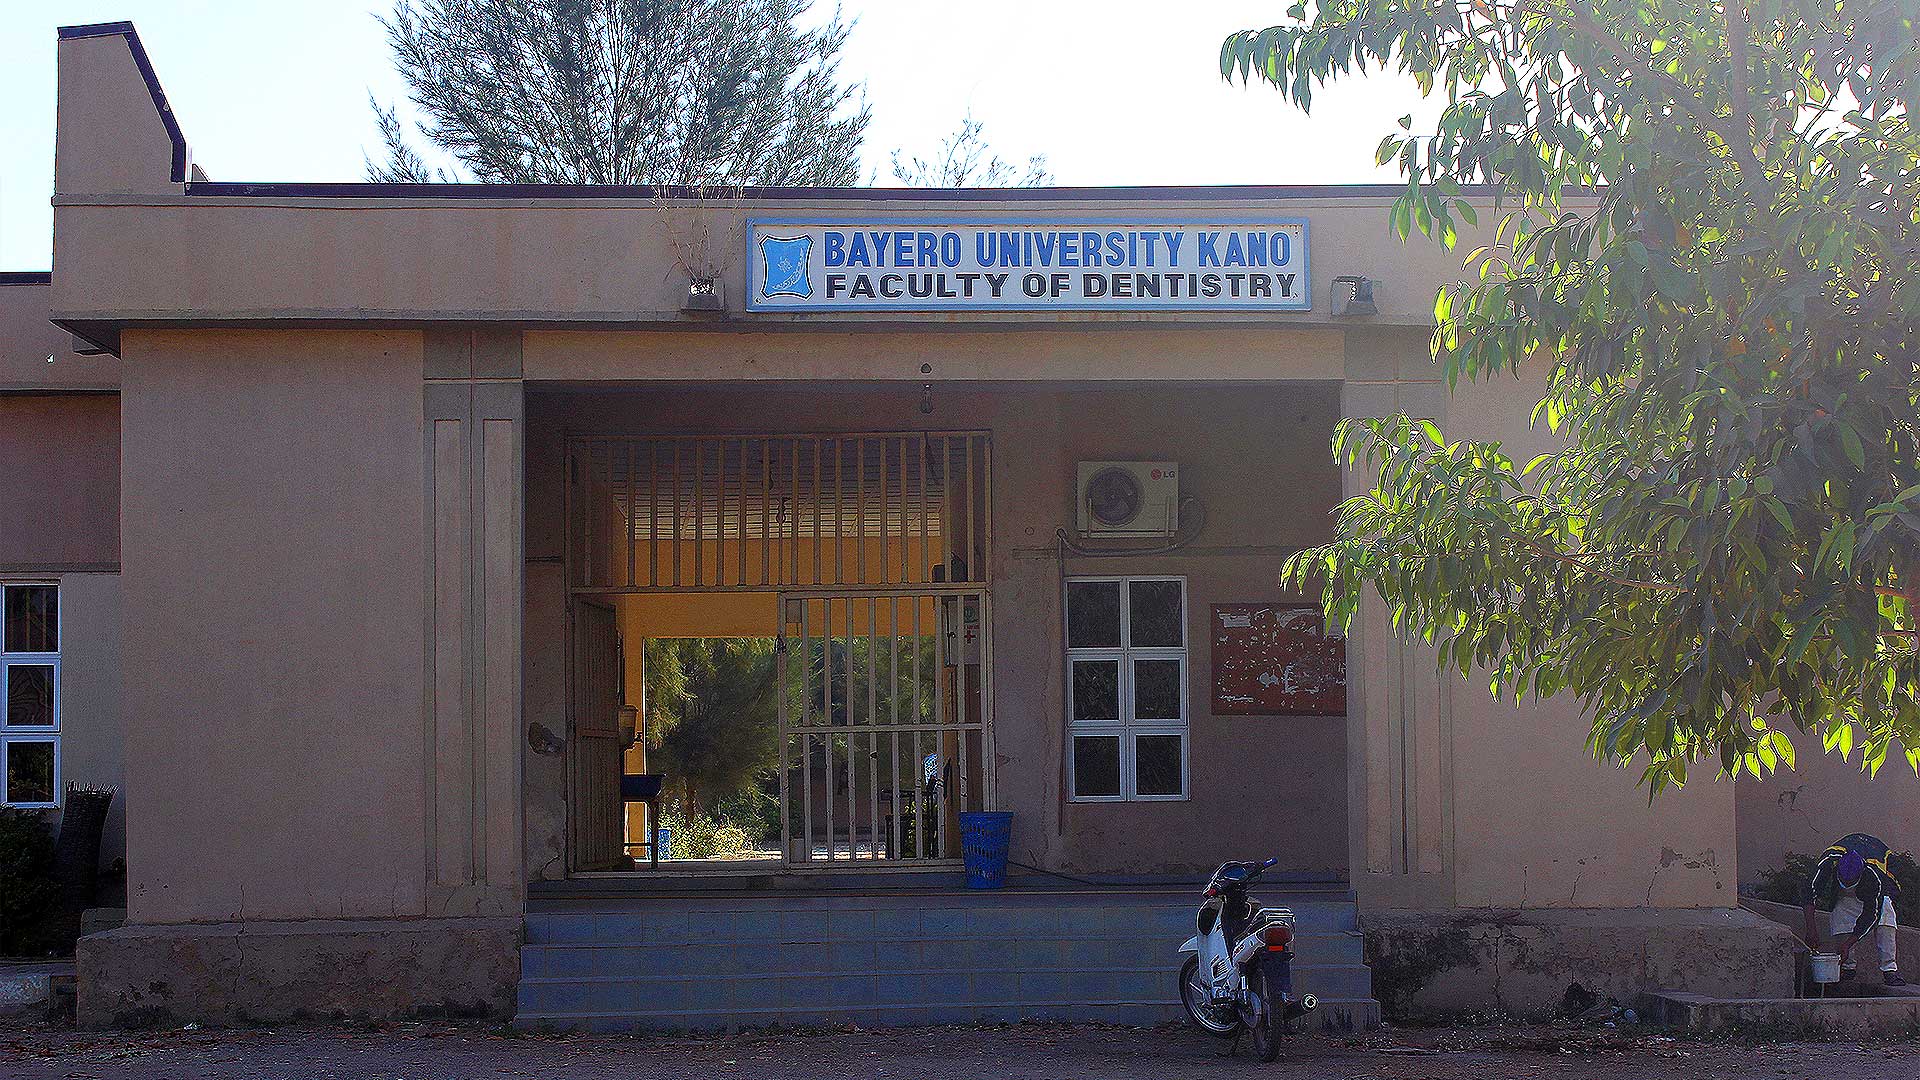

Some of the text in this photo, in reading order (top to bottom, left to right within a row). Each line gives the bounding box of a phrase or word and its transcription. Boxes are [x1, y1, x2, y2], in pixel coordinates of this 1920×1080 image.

[824, 231, 1291, 267] BAYERO UNIVERSITY KANO
[826, 273, 1297, 298] FACULTY OF DENTISTRY
